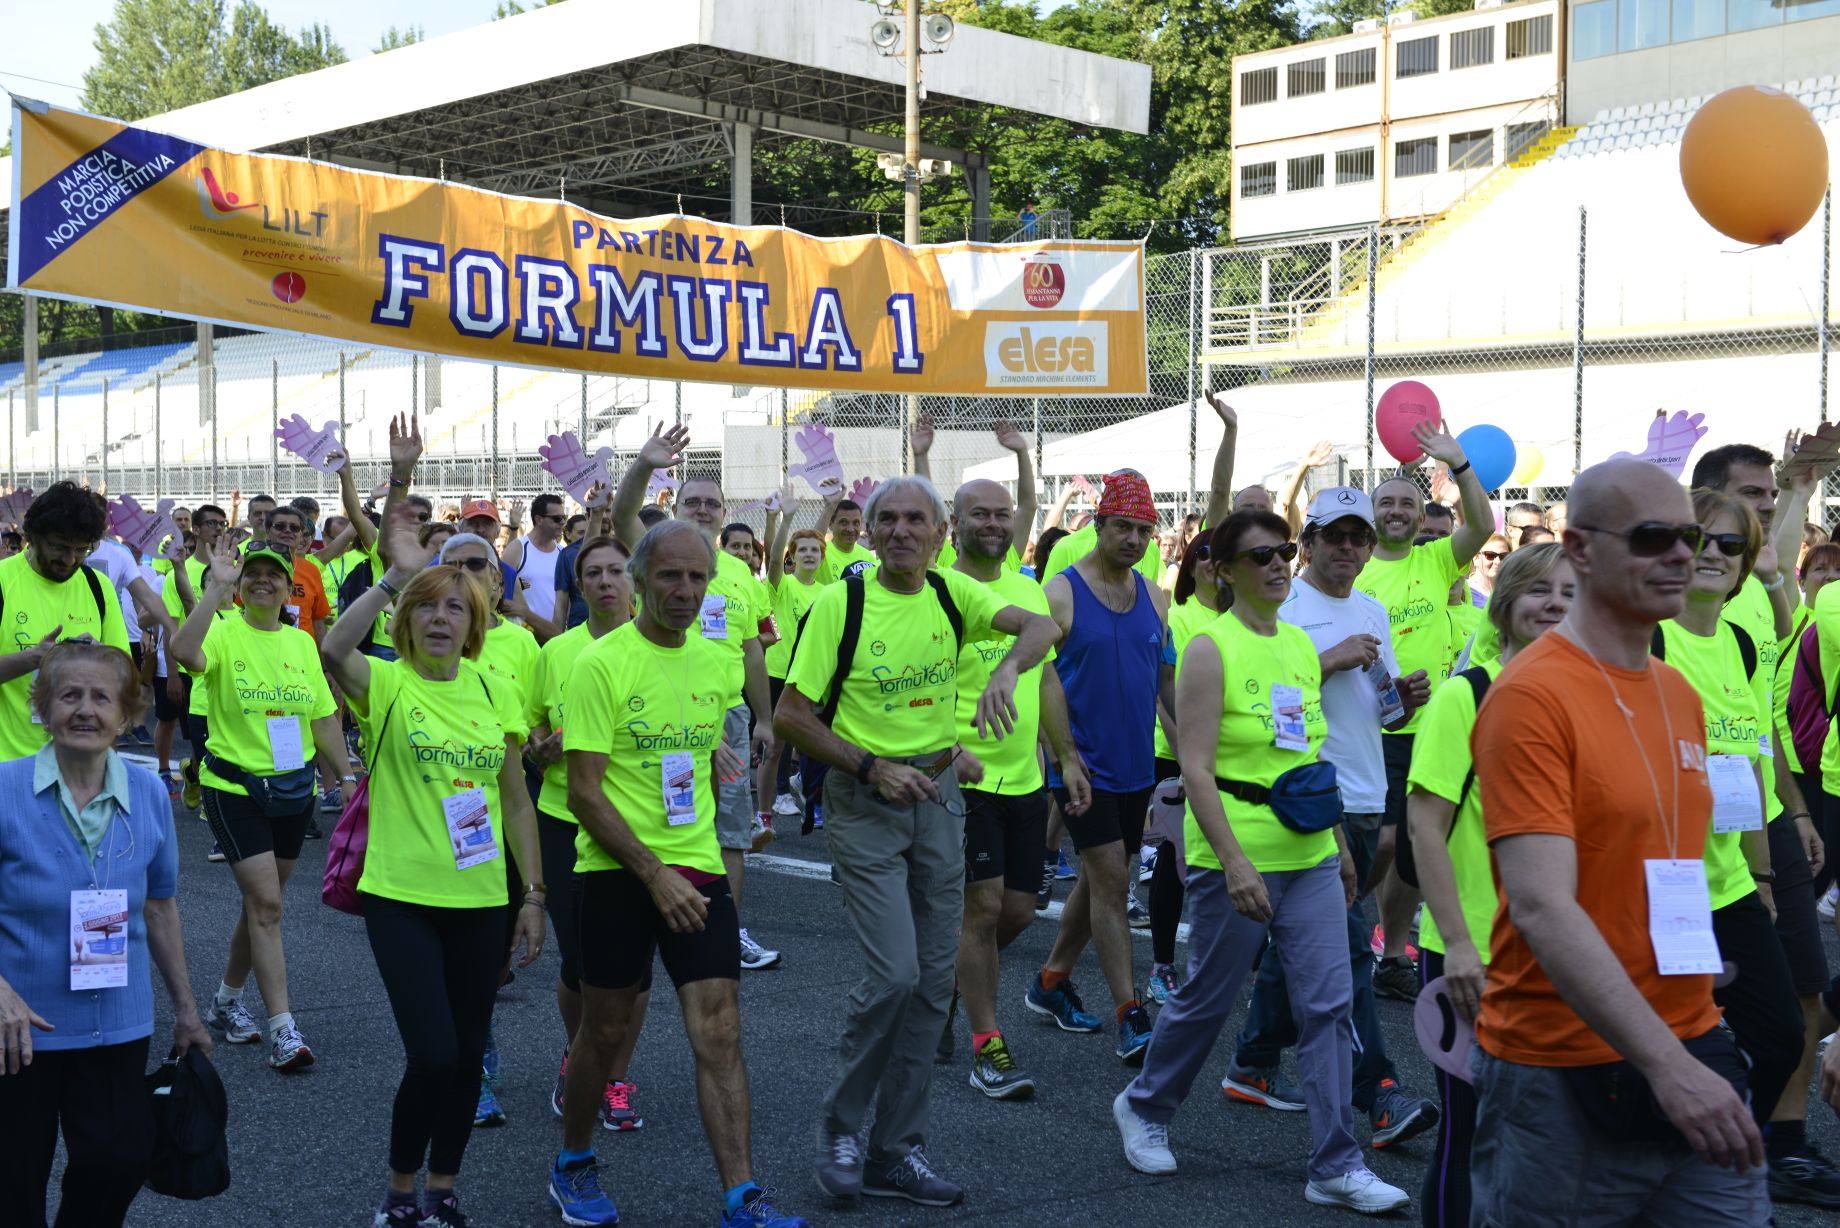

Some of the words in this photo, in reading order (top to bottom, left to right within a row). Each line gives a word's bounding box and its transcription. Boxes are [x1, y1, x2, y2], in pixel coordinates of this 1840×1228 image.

[58, 149, 118, 195] MARCIA
[60, 160, 138, 215] PODISTICA
[45, 212, 86, 250] NON
[84, 153, 175, 221] COMPETITIVA
[263, 204, 329, 238] LILT
[242, 249, 296, 261] prevenire
[308, 253, 342, 264] vivere
[572, 220, 754, 267] PARTENZA
[1030, 263, 1054, 288] 60
[370, 233, 863, 372] FORMULA
[887, 292, 925, 374] 1
[998, 327, 1096, 373] elesa
[1000, 375, 1035, 384] STANDARD
[1035, 375, 1065, 384] MACHINE
